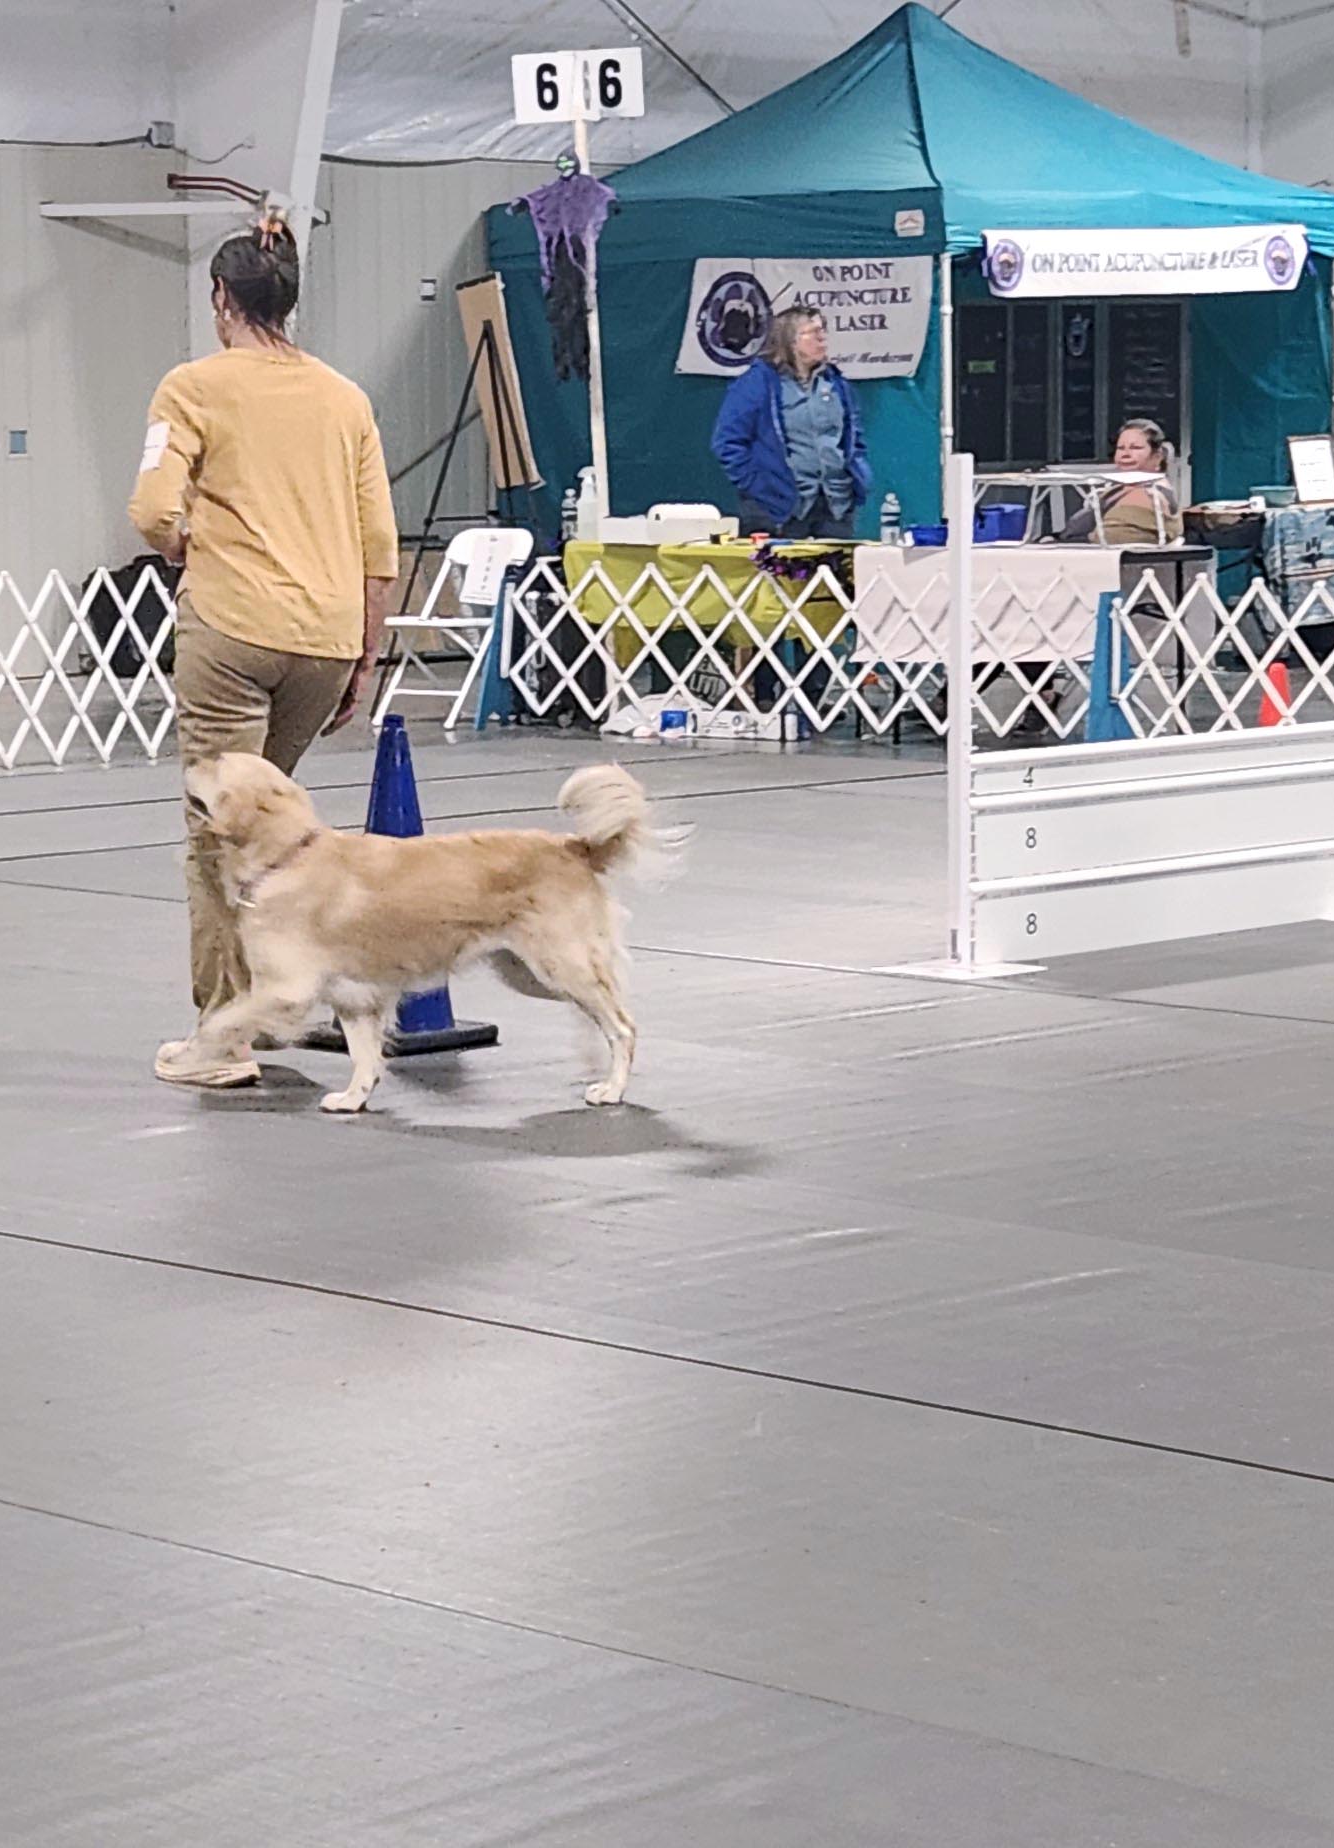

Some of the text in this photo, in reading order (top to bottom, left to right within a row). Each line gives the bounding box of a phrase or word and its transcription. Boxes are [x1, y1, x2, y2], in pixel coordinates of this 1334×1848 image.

[536, 62, 559, 111] 6
[598, 58, 623, 108] 6
[812, 262, 894, 282] ON POINT
[1032, 252, 1055, 273] ON
[1057, 252, 1101, 273] POINT
[793, 286, 912, 307] ACUPUNCTURE
[1025, 827, 1037, 849] 8
[1026, 913, 1038, 935] 8
